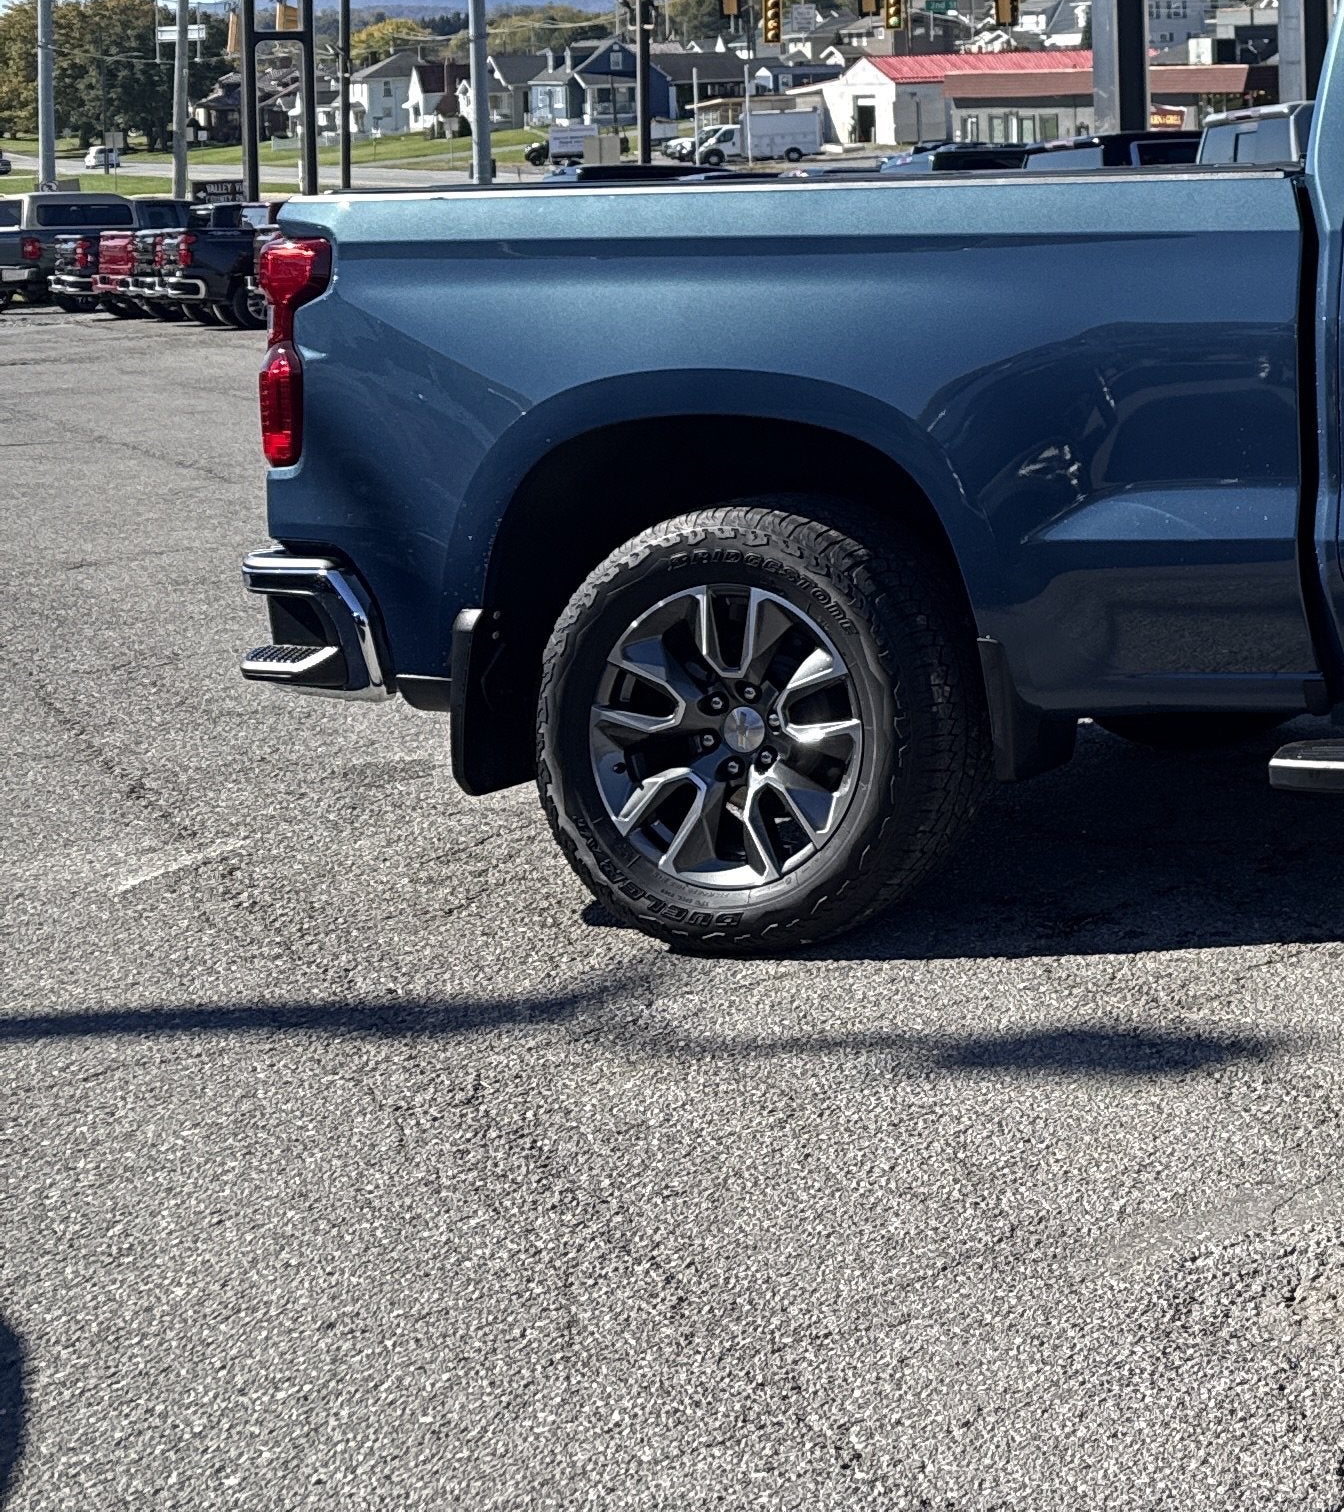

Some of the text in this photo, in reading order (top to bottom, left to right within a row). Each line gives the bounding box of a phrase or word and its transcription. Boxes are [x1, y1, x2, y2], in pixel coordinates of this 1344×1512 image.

[206, 183, 233, 194] VALLEY
[668, 548, 857, 634] BRIDGESTONE
[600, 858, 744, 928] DUELER
